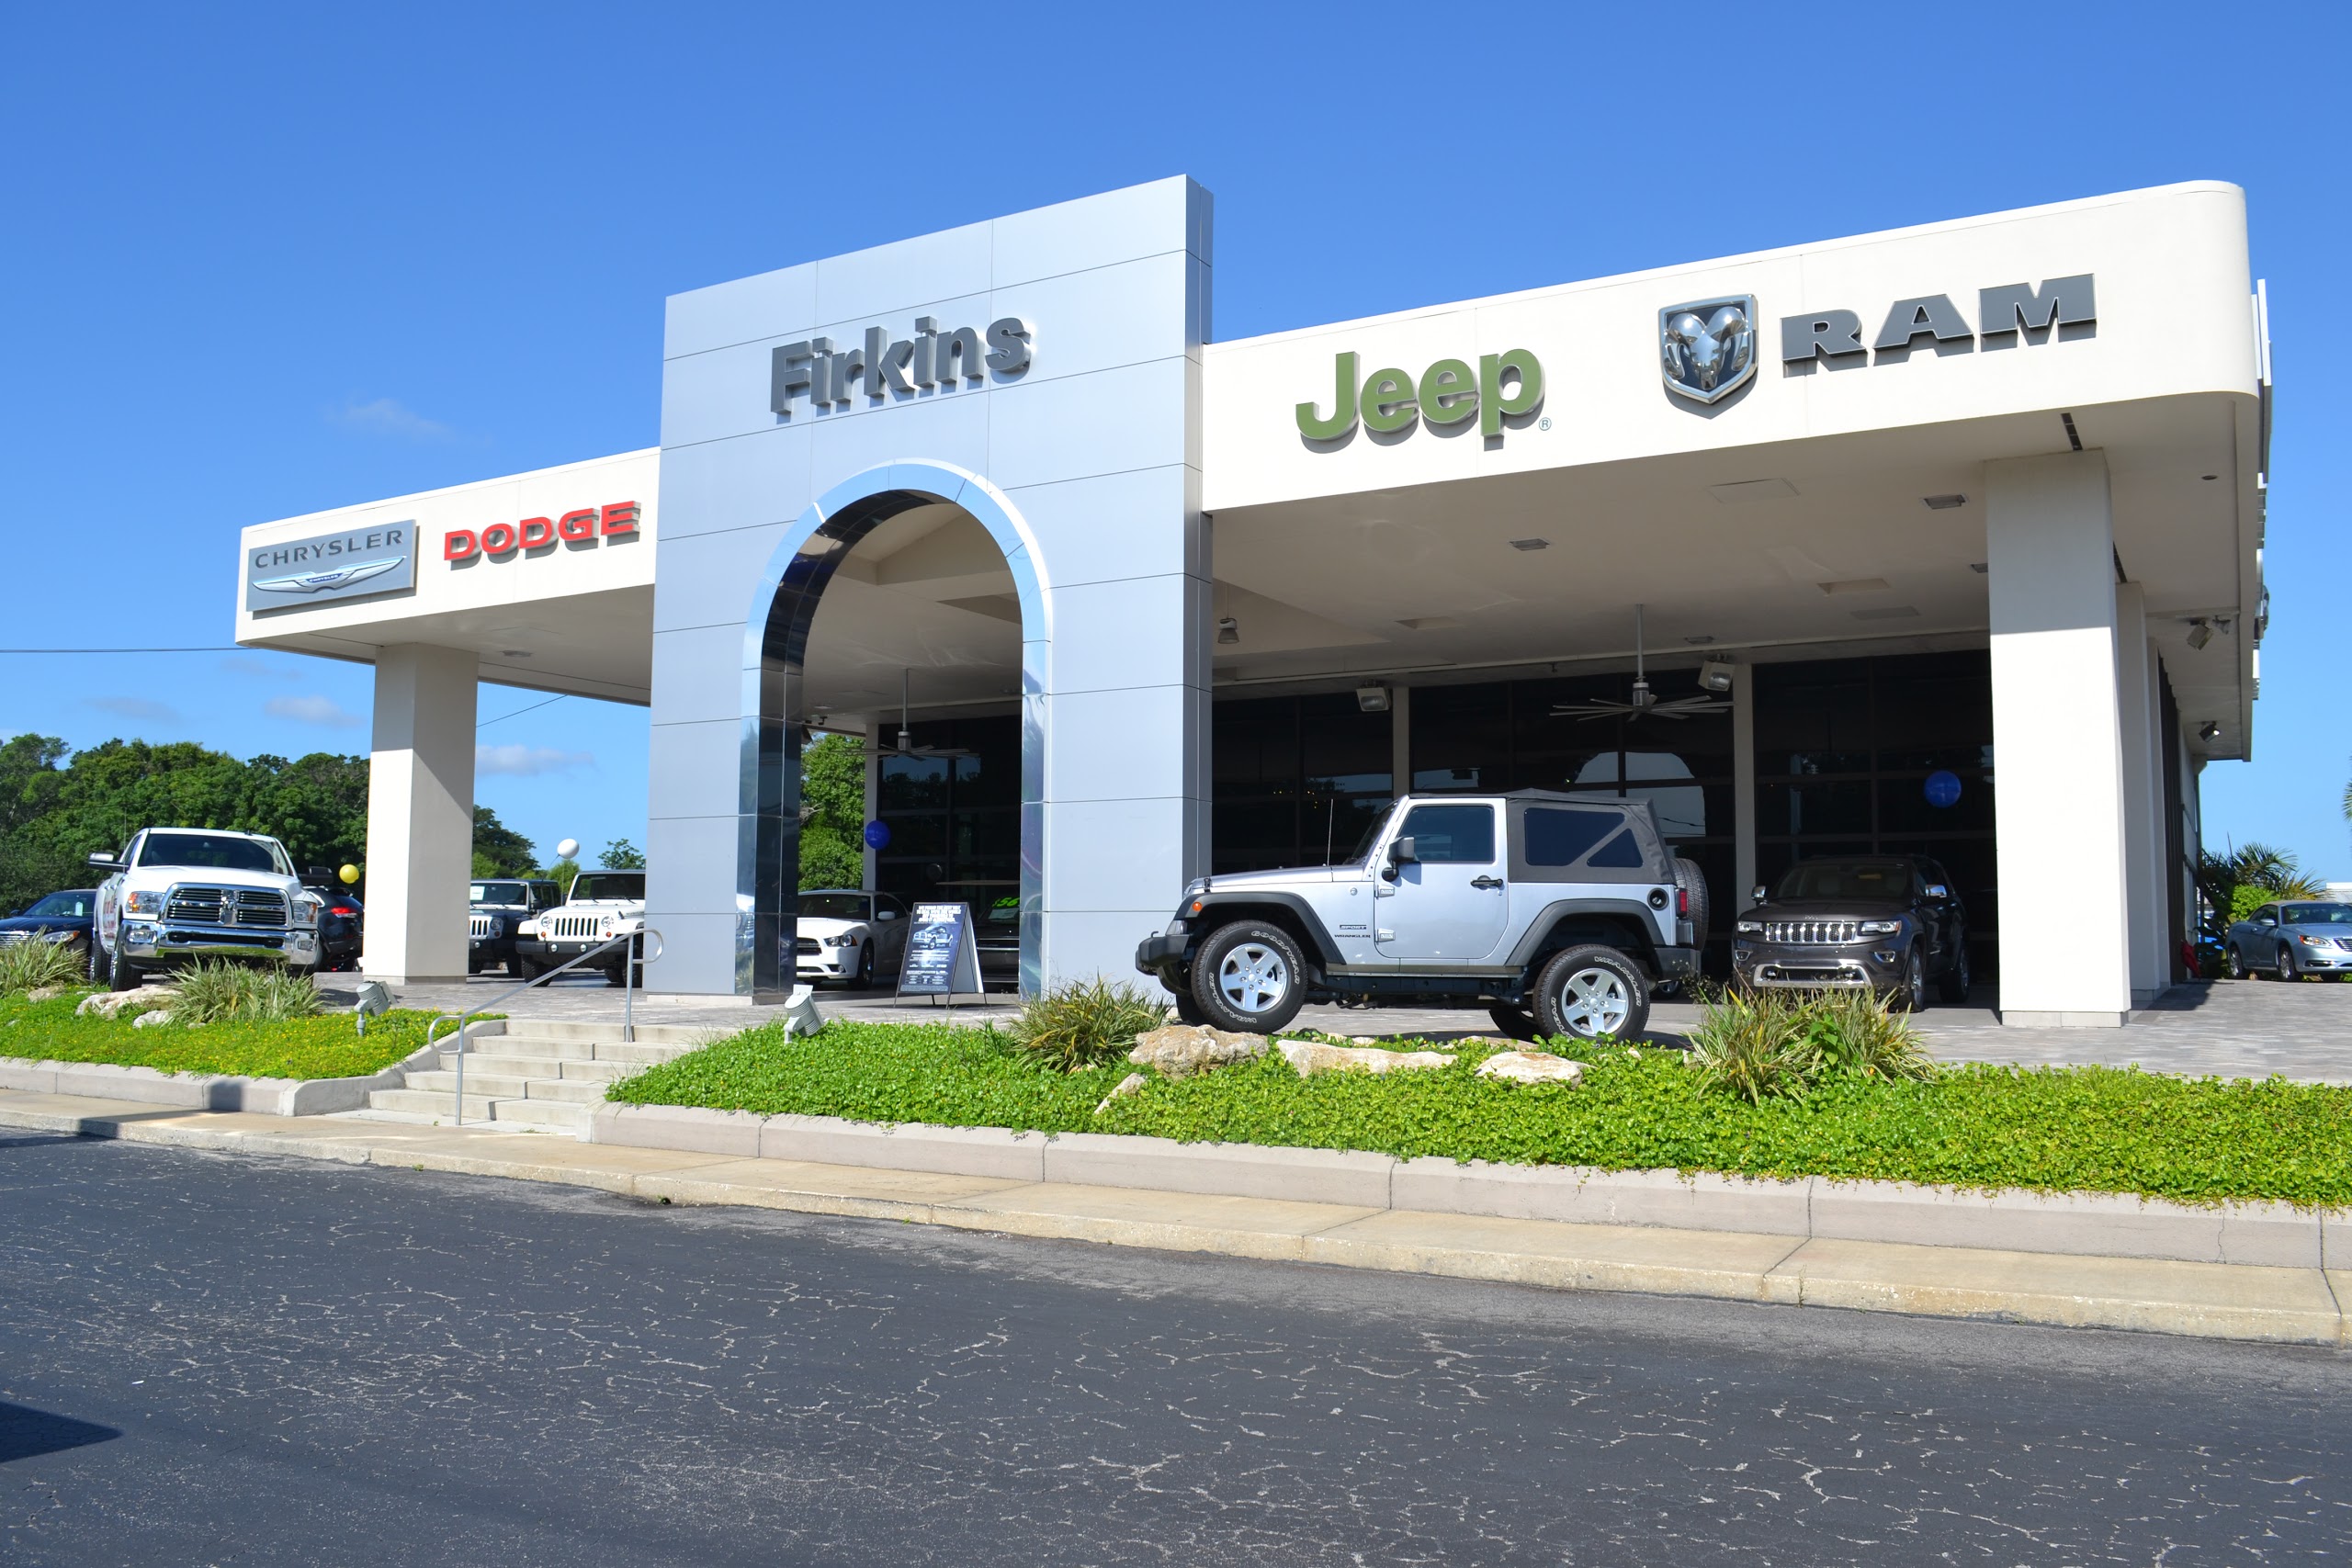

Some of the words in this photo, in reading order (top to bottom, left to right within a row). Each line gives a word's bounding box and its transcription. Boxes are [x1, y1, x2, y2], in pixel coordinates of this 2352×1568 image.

[1780, 272, 2098, 364] RAM
[770, 315, 1031, 414] Firkins
[1295, 348, 1545, 437] Jeep
[254, 529, 403, 569] CHRYSLER
[444, 501, 641, 561] DODGE
[308, 573, 339, 583] CHRYSLER
[1251, 930, 1300, 985] GOODYEAR
[1594, 955, 1642, 1008] WRANGLER
[1207, 971, 1258, 1024] WRANGLER
